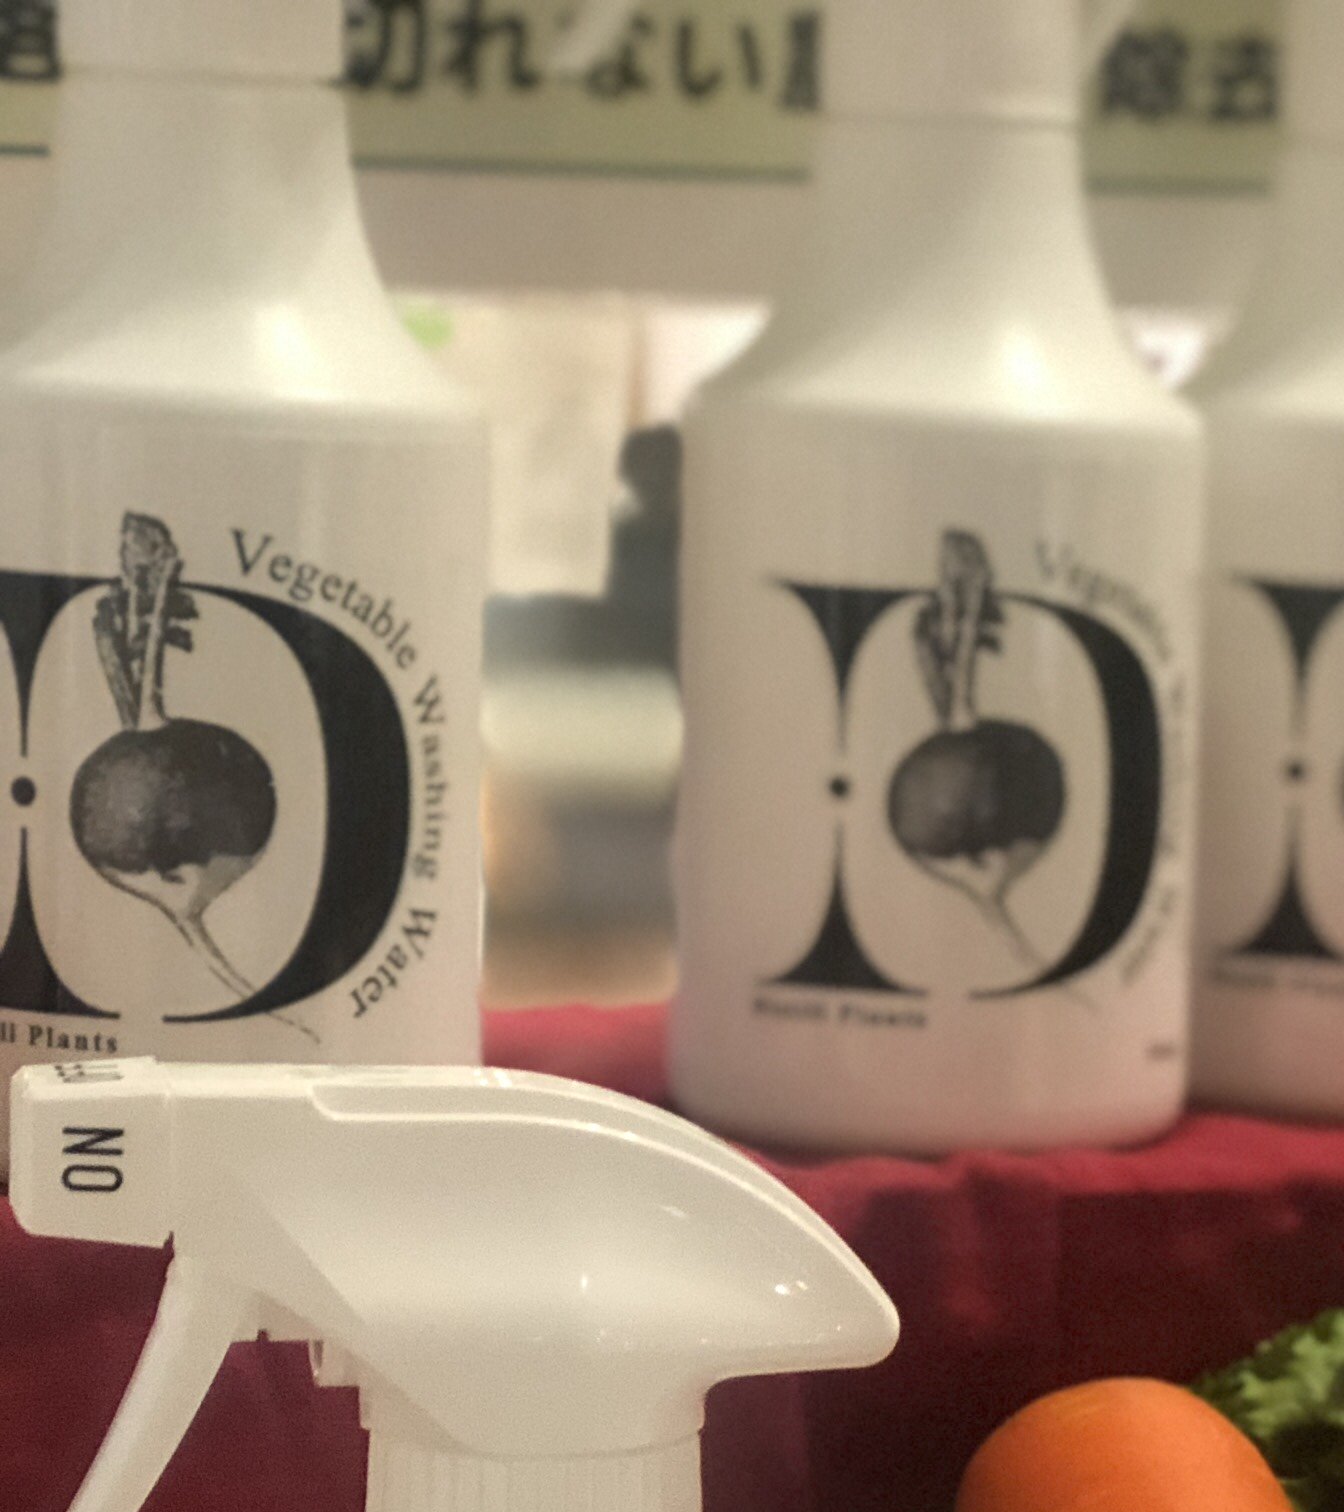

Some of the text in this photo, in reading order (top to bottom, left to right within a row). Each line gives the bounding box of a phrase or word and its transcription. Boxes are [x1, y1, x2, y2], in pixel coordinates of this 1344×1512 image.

[230, 527, 448, 1020] Vegetable Washing Water
[28, 1024, 118, 1054] Plants
[61, 1127, 125, 1193] ON
